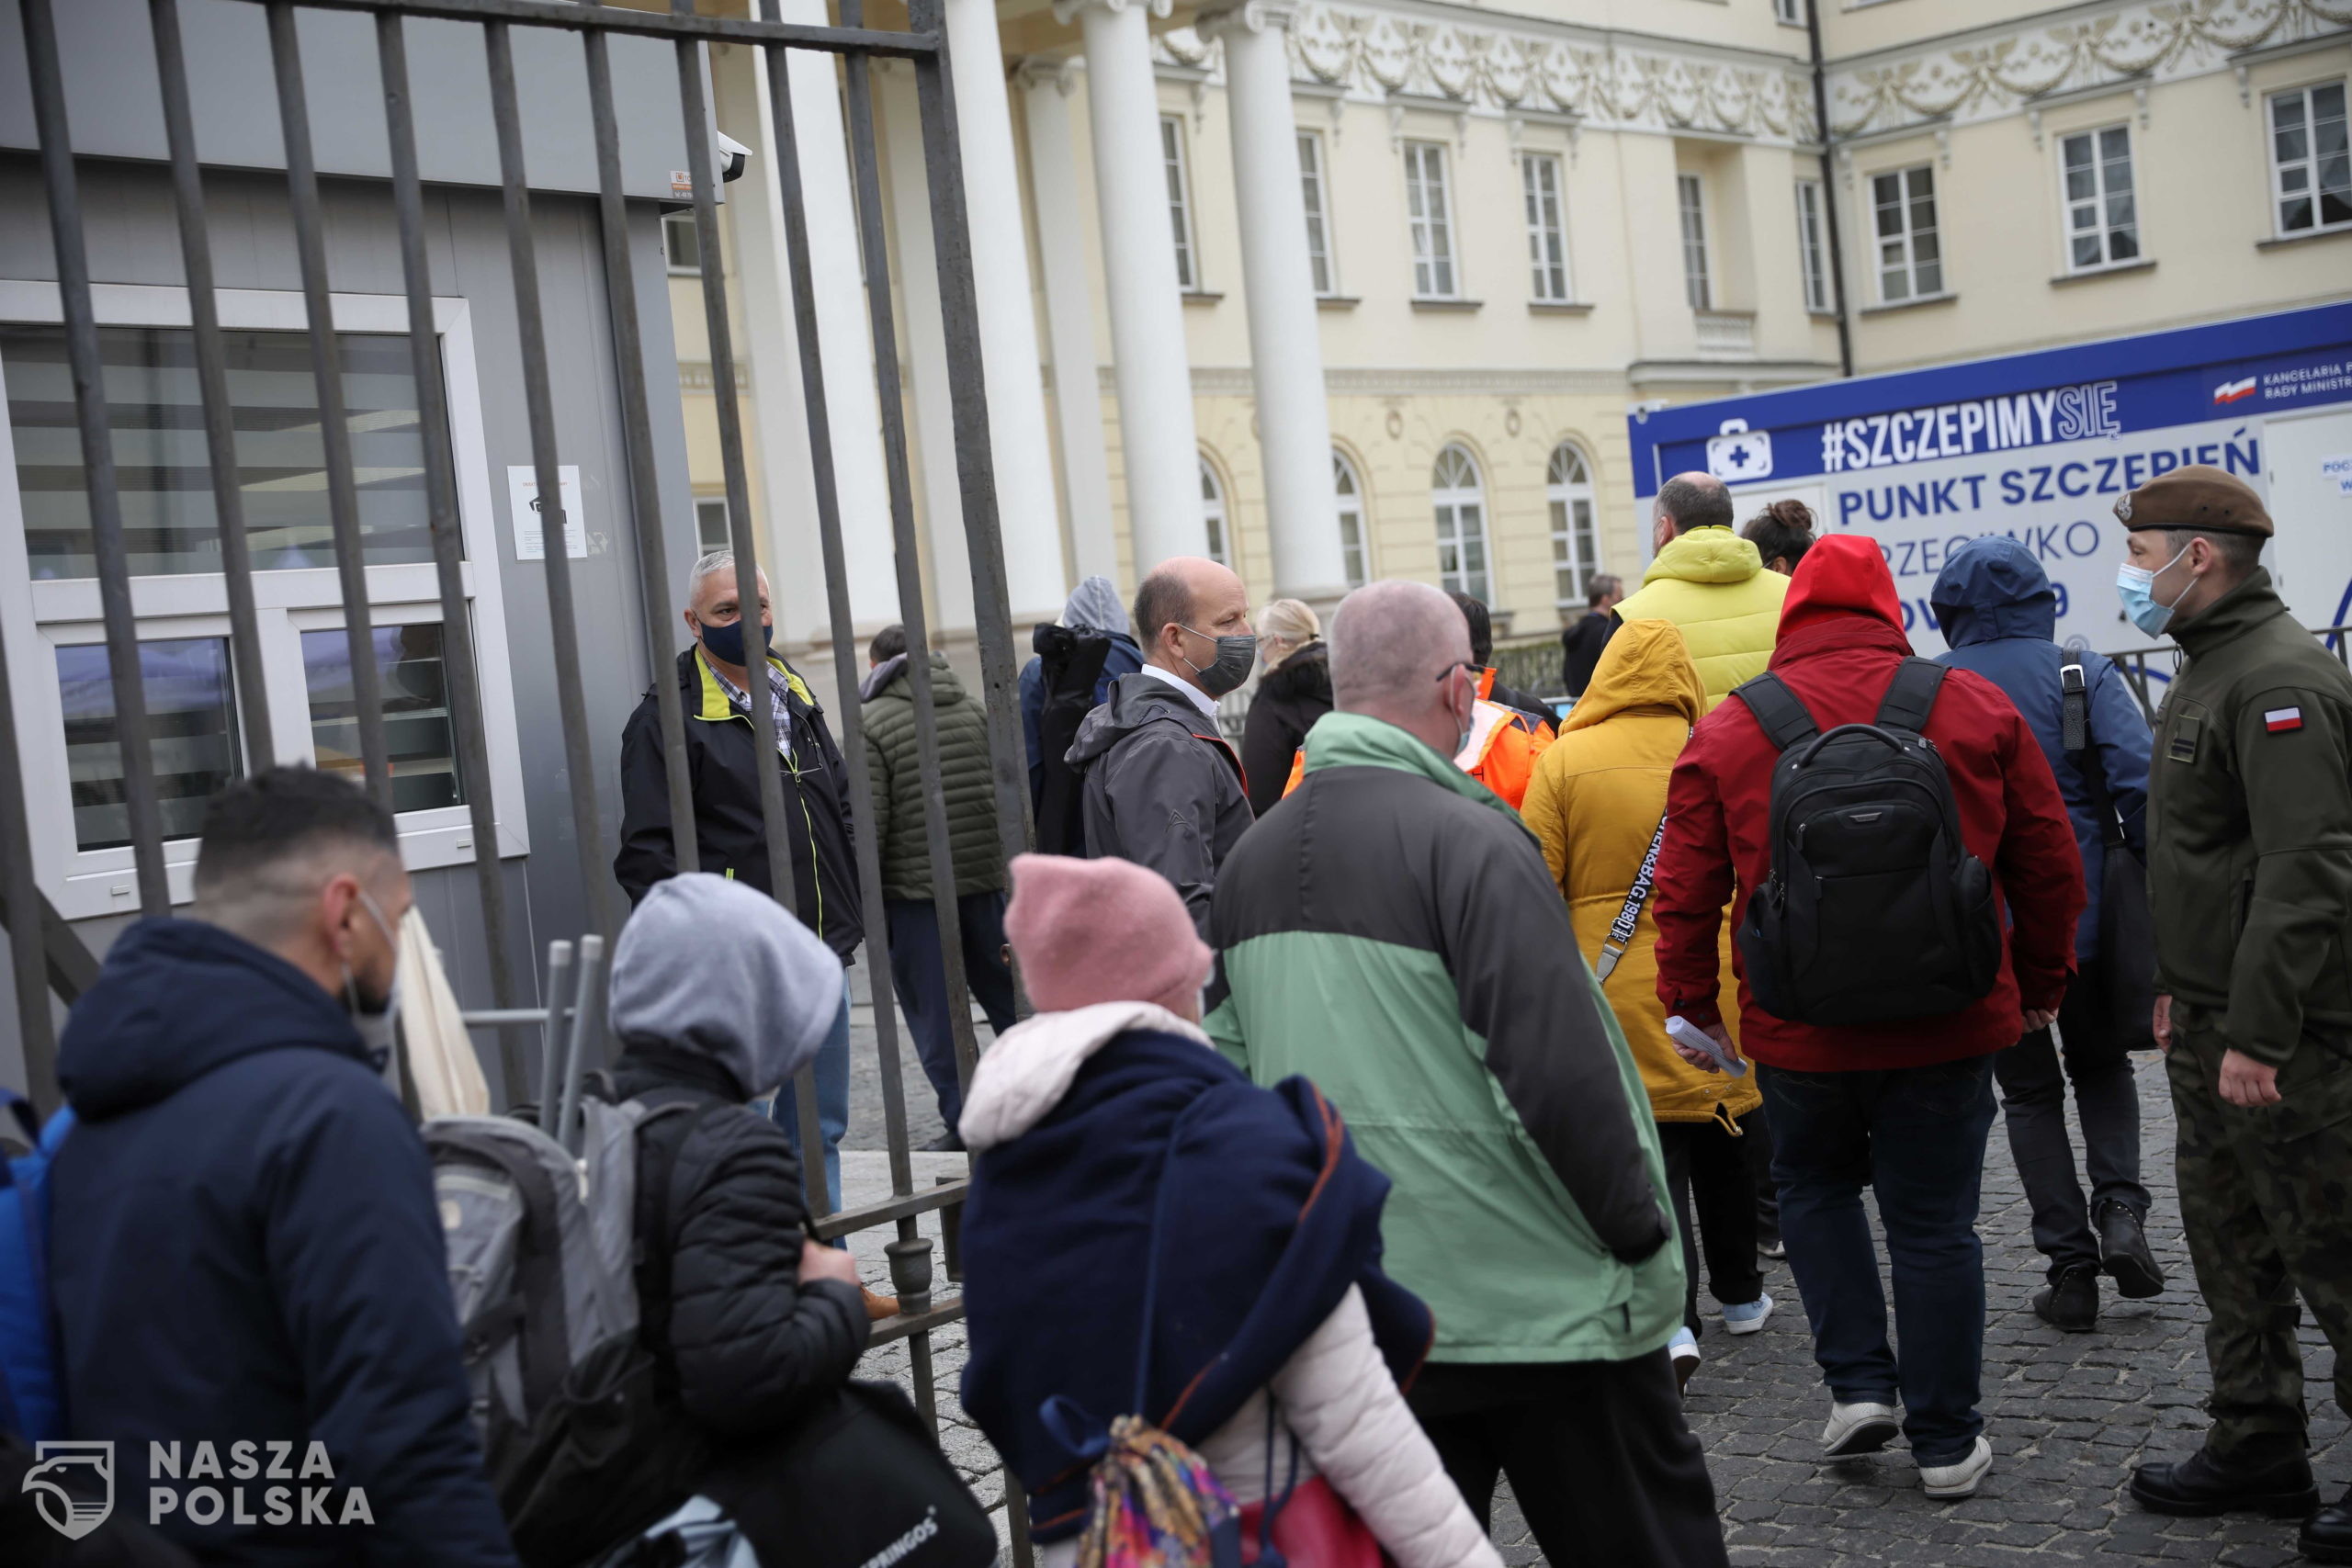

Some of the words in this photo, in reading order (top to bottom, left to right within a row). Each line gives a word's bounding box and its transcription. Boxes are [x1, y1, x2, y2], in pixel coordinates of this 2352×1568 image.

[2263, 364, 2342, 387] KANCELARIA
[2264, 384, 2298, 400] RADY
[1838, 474, 1986, 525] PUNKT
[860, 1517, 939, 1568] PRINGOS
